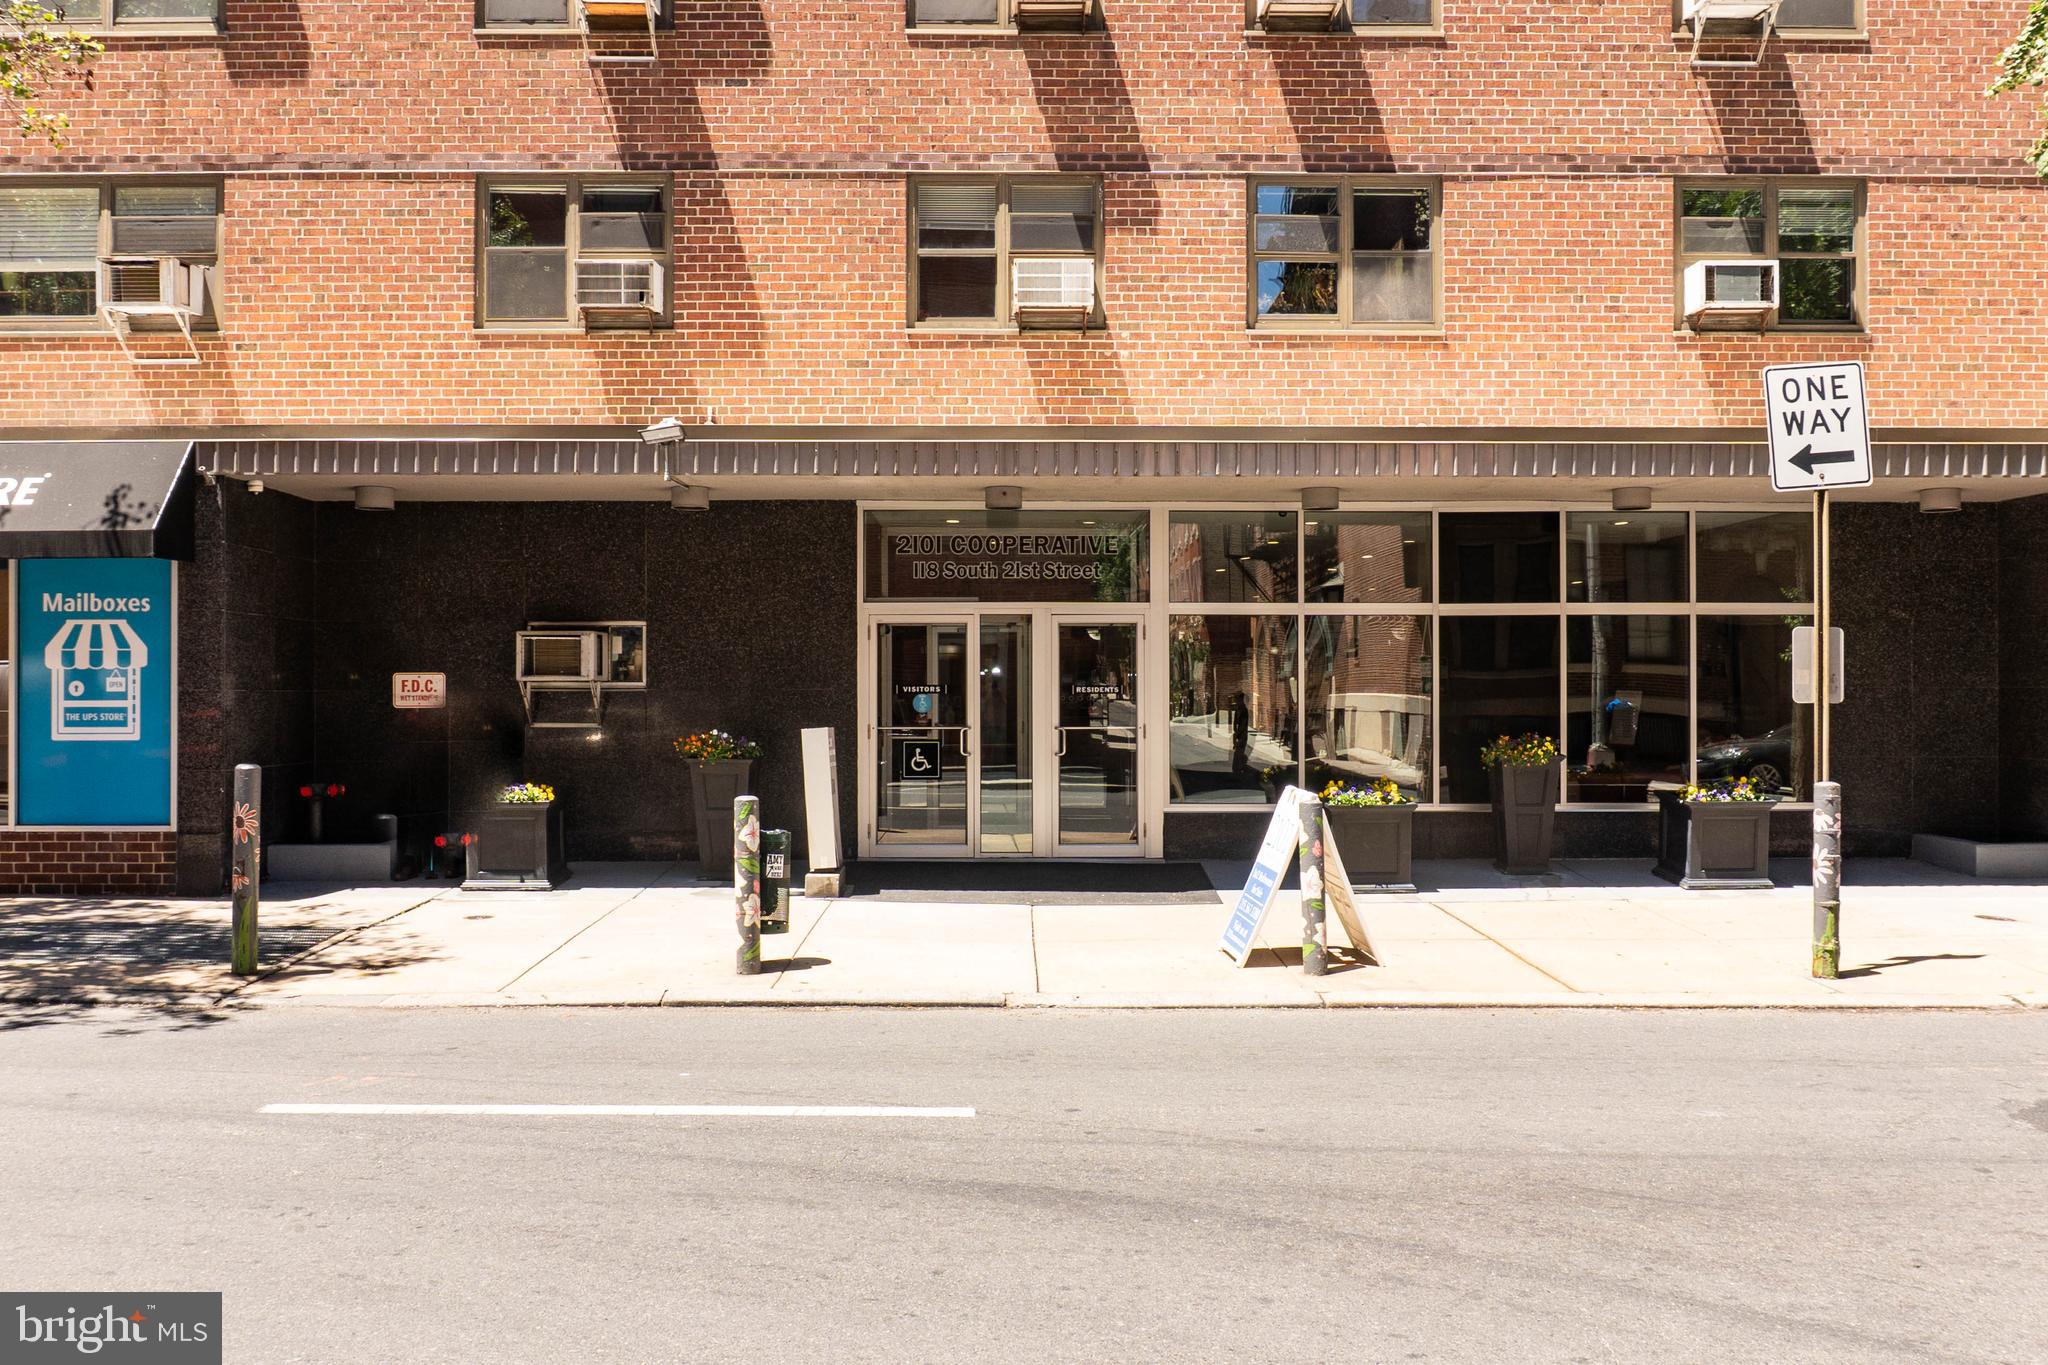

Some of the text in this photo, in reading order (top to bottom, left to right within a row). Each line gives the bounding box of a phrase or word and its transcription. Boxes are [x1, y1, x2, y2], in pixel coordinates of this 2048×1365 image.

[1782, 374, 1849, 403] ONE
[1782, 407, 1851, 436] WAY
[896, 534, 1119, 555] 2101 COOPERATIVE
[913, 561, 1101, 579] 118 South 21st Street
[42, 592, 151, 612] Mailboxes
[401, 679, 437, 692] F.D.C.
[65, 713, 125, 721] THE UPS STORE
